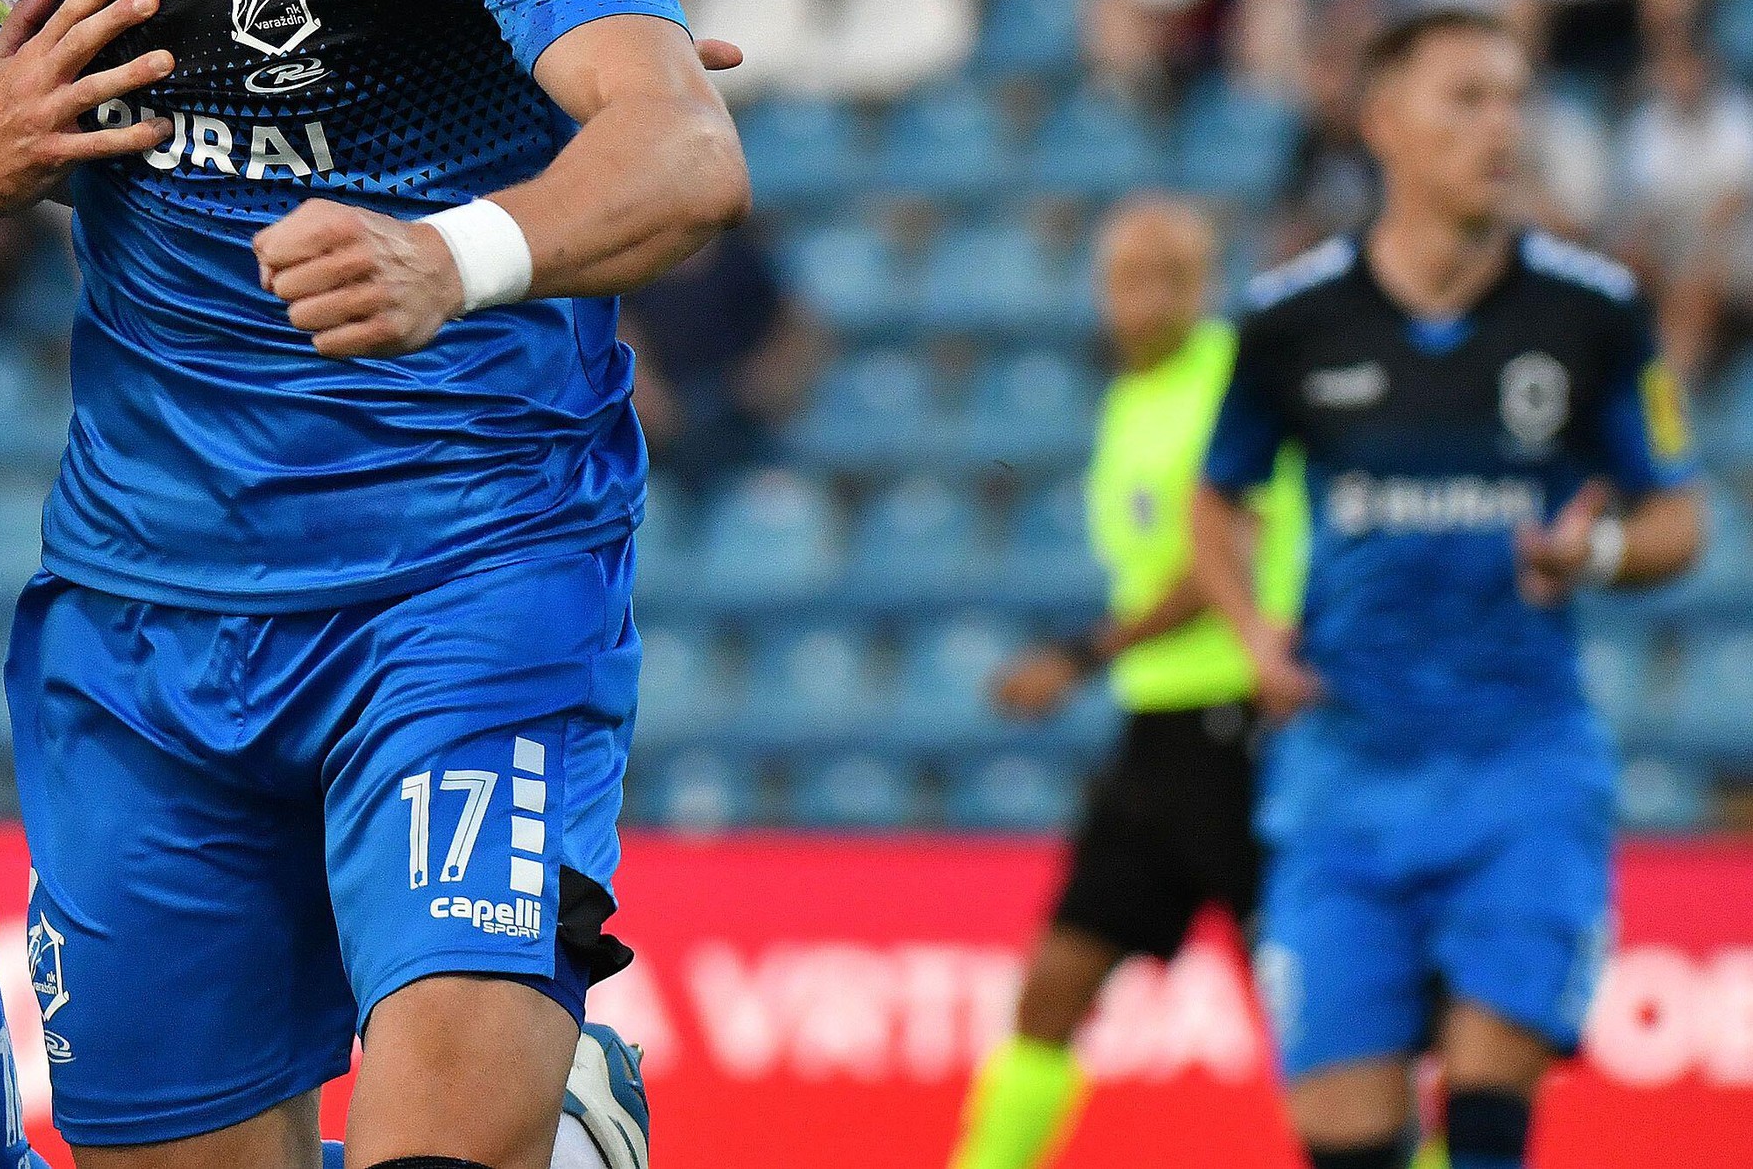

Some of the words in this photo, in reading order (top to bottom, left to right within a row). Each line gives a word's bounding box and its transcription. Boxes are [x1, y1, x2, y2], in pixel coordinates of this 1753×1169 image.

[285, 3, 302, 15] nk
[254, 14, 306, 30] varaždin
[400, 769, 499, 891] 17
[429, 896, 542, 931] capelli
[482, 921, 541, 940] SPORT
